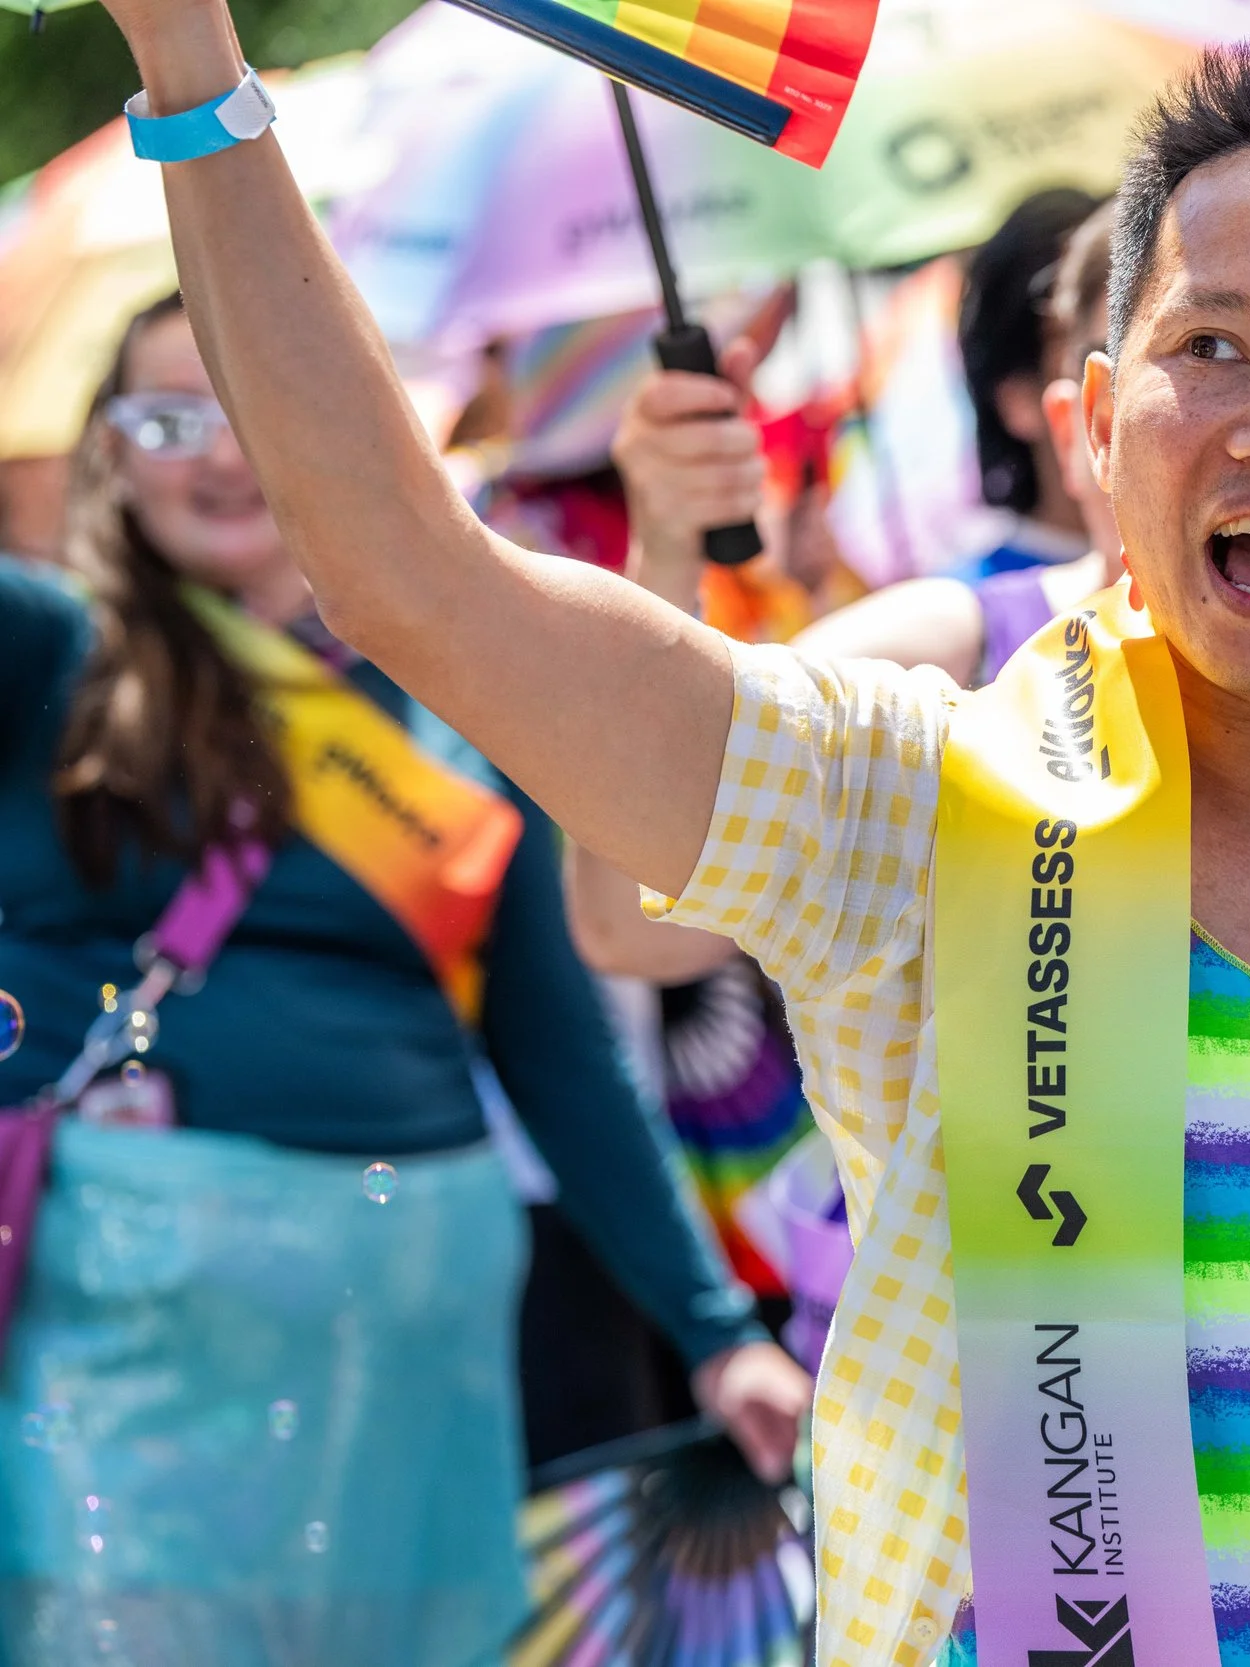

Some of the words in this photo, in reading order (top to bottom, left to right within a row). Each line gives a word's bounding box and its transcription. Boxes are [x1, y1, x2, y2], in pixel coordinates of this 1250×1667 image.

[1027, 818, 1077, 1139] VETASSESS
[1034, 1324, 1098, 1575] KANGAN
[1094, 1433, 1124, 1575] INSTITUTE
